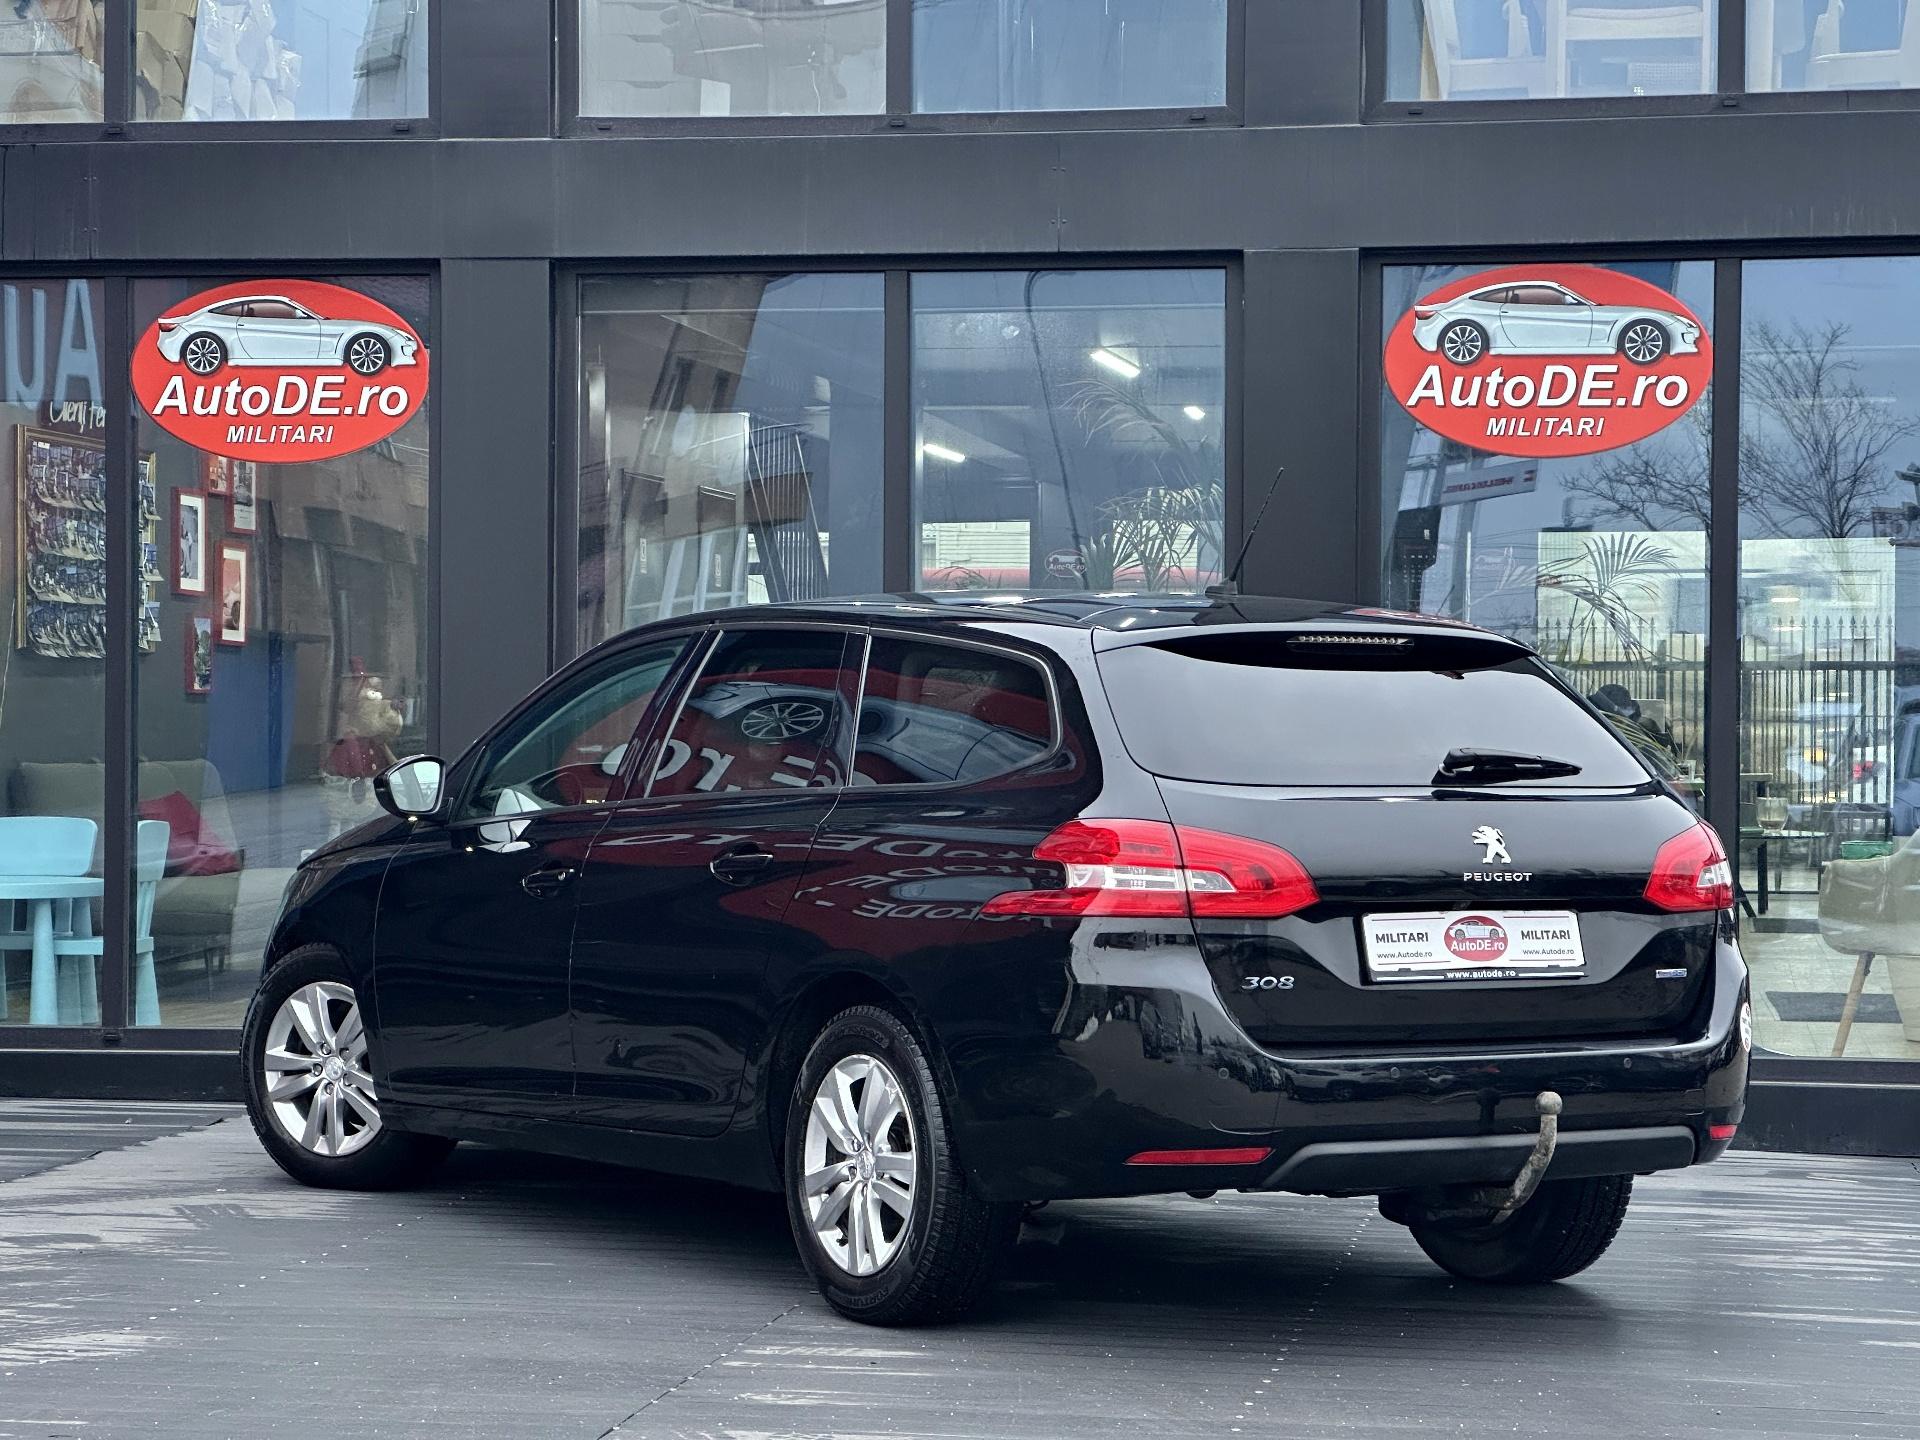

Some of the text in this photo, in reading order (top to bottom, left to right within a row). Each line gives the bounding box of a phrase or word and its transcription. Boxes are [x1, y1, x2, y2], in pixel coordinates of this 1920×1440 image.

[1405, 364, 1688, 408] AutoDE.ro
[152, 375, 408, 416] AutoDE.ro
[1486, 417, 1605, 436] MILITARI
[226, 425, 334, 443] MILITARI
[1463, 872, 1532, 882] PEUGEOT
[1375, 932, 1428, 943] MILITARI
[1521, 929, 1570, 940] MILITARI
[1450, 940, 1505, 952] AutoDE.ro
[1377, 951, 1432, 959] www.Autode.ro
[1522, 948, 1574, 956] www.Autode.ro
[1446, 970, 1516, 978] www.autode.ro
[1241, 975, 1295, 990] 308
